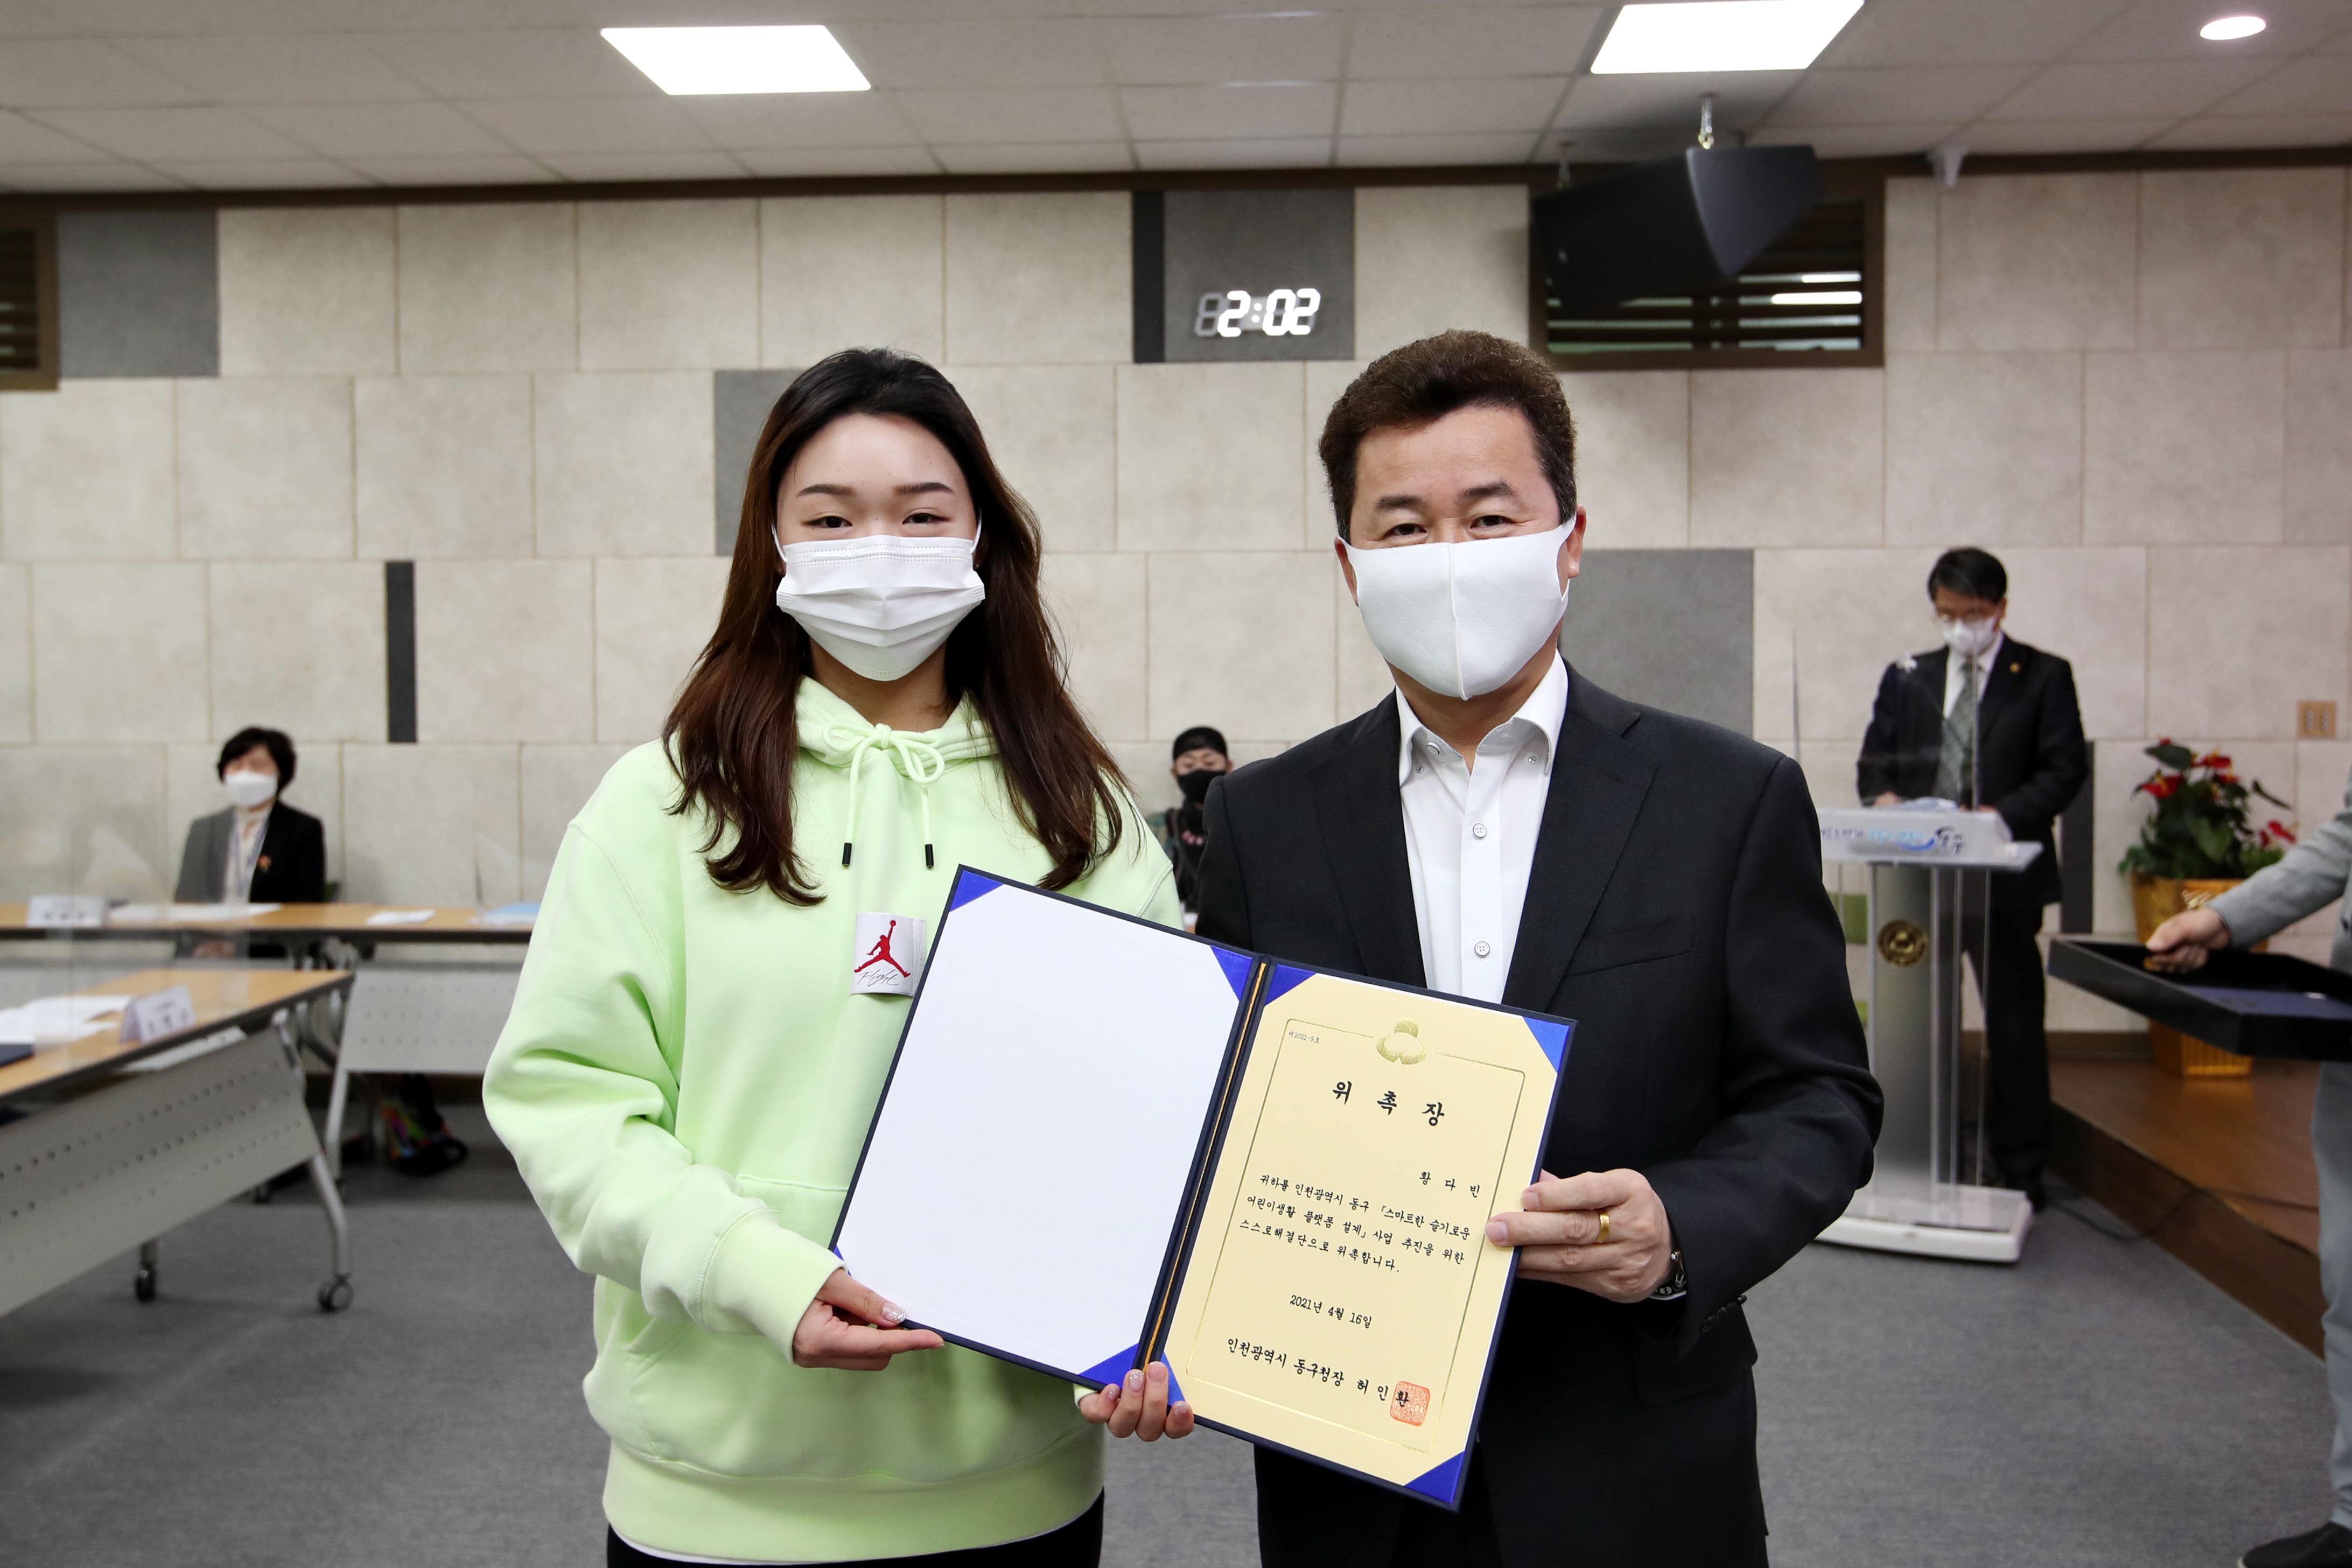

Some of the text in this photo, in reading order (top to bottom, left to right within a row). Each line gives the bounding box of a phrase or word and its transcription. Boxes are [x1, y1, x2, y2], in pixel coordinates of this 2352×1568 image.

[1217, 288, 1321, 337] 2:02
[857, 969, 899, 986] Flight
[1247, 1195, 1296, 1218] 어린이생활
[1304, 1210, 1334, 1228] 플랫폼
[1372, 1230, 1393, 1245] 사업
[1402, 1237, 1434, 1256] 추진을
[1442, 1249, 1465, 1264] 위한
[1260, 1174, 1289, 1191] 귀하를
[1296, 1184, 1343, 1206] 인천광역시
[1349, 1198, 1369, 1213] 동구
[1429, 1219, 1471, 1240] 슬기로운
[1239, 1219, 1399, 1272] 스스로해결단으로 위촉합니다.
[1289, 1294, 1373, 1328] 2021년 4월 16일
[1227, 1337, 1287, 1369] 인천광역시
[1293, 1359, 1345, 1387] 동구청장
